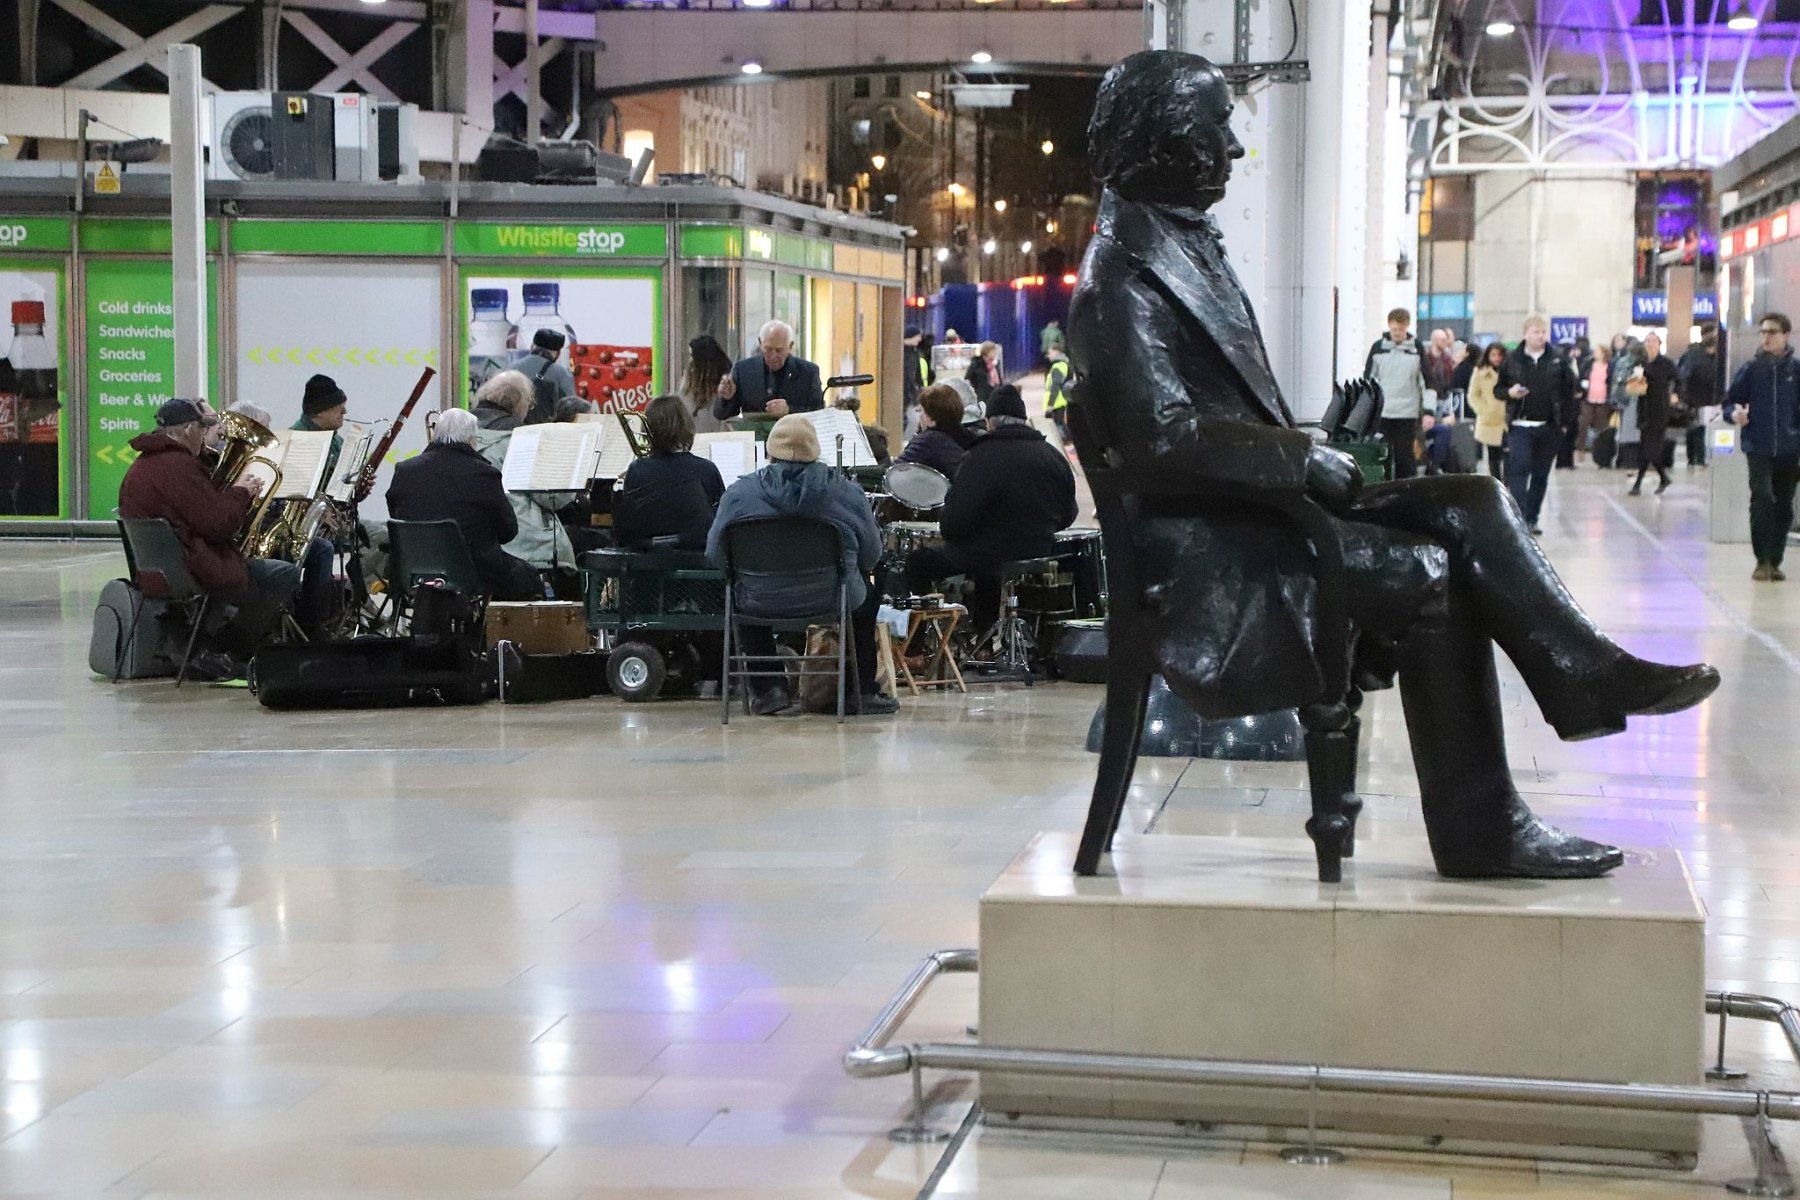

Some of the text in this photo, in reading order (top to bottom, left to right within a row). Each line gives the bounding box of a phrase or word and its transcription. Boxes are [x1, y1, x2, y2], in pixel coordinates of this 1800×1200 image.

[497, 226, 625, 253] Whistlestop
[99, 301, 172, 315] Cold drinks
[99, 347, 146, 360] Snacks
[99, 369, 162, 382] Groceries
[100, 393, 130, 405] Beer
[133, 393, 144, 406] &
[100, 417, 140, 432] Spirits
